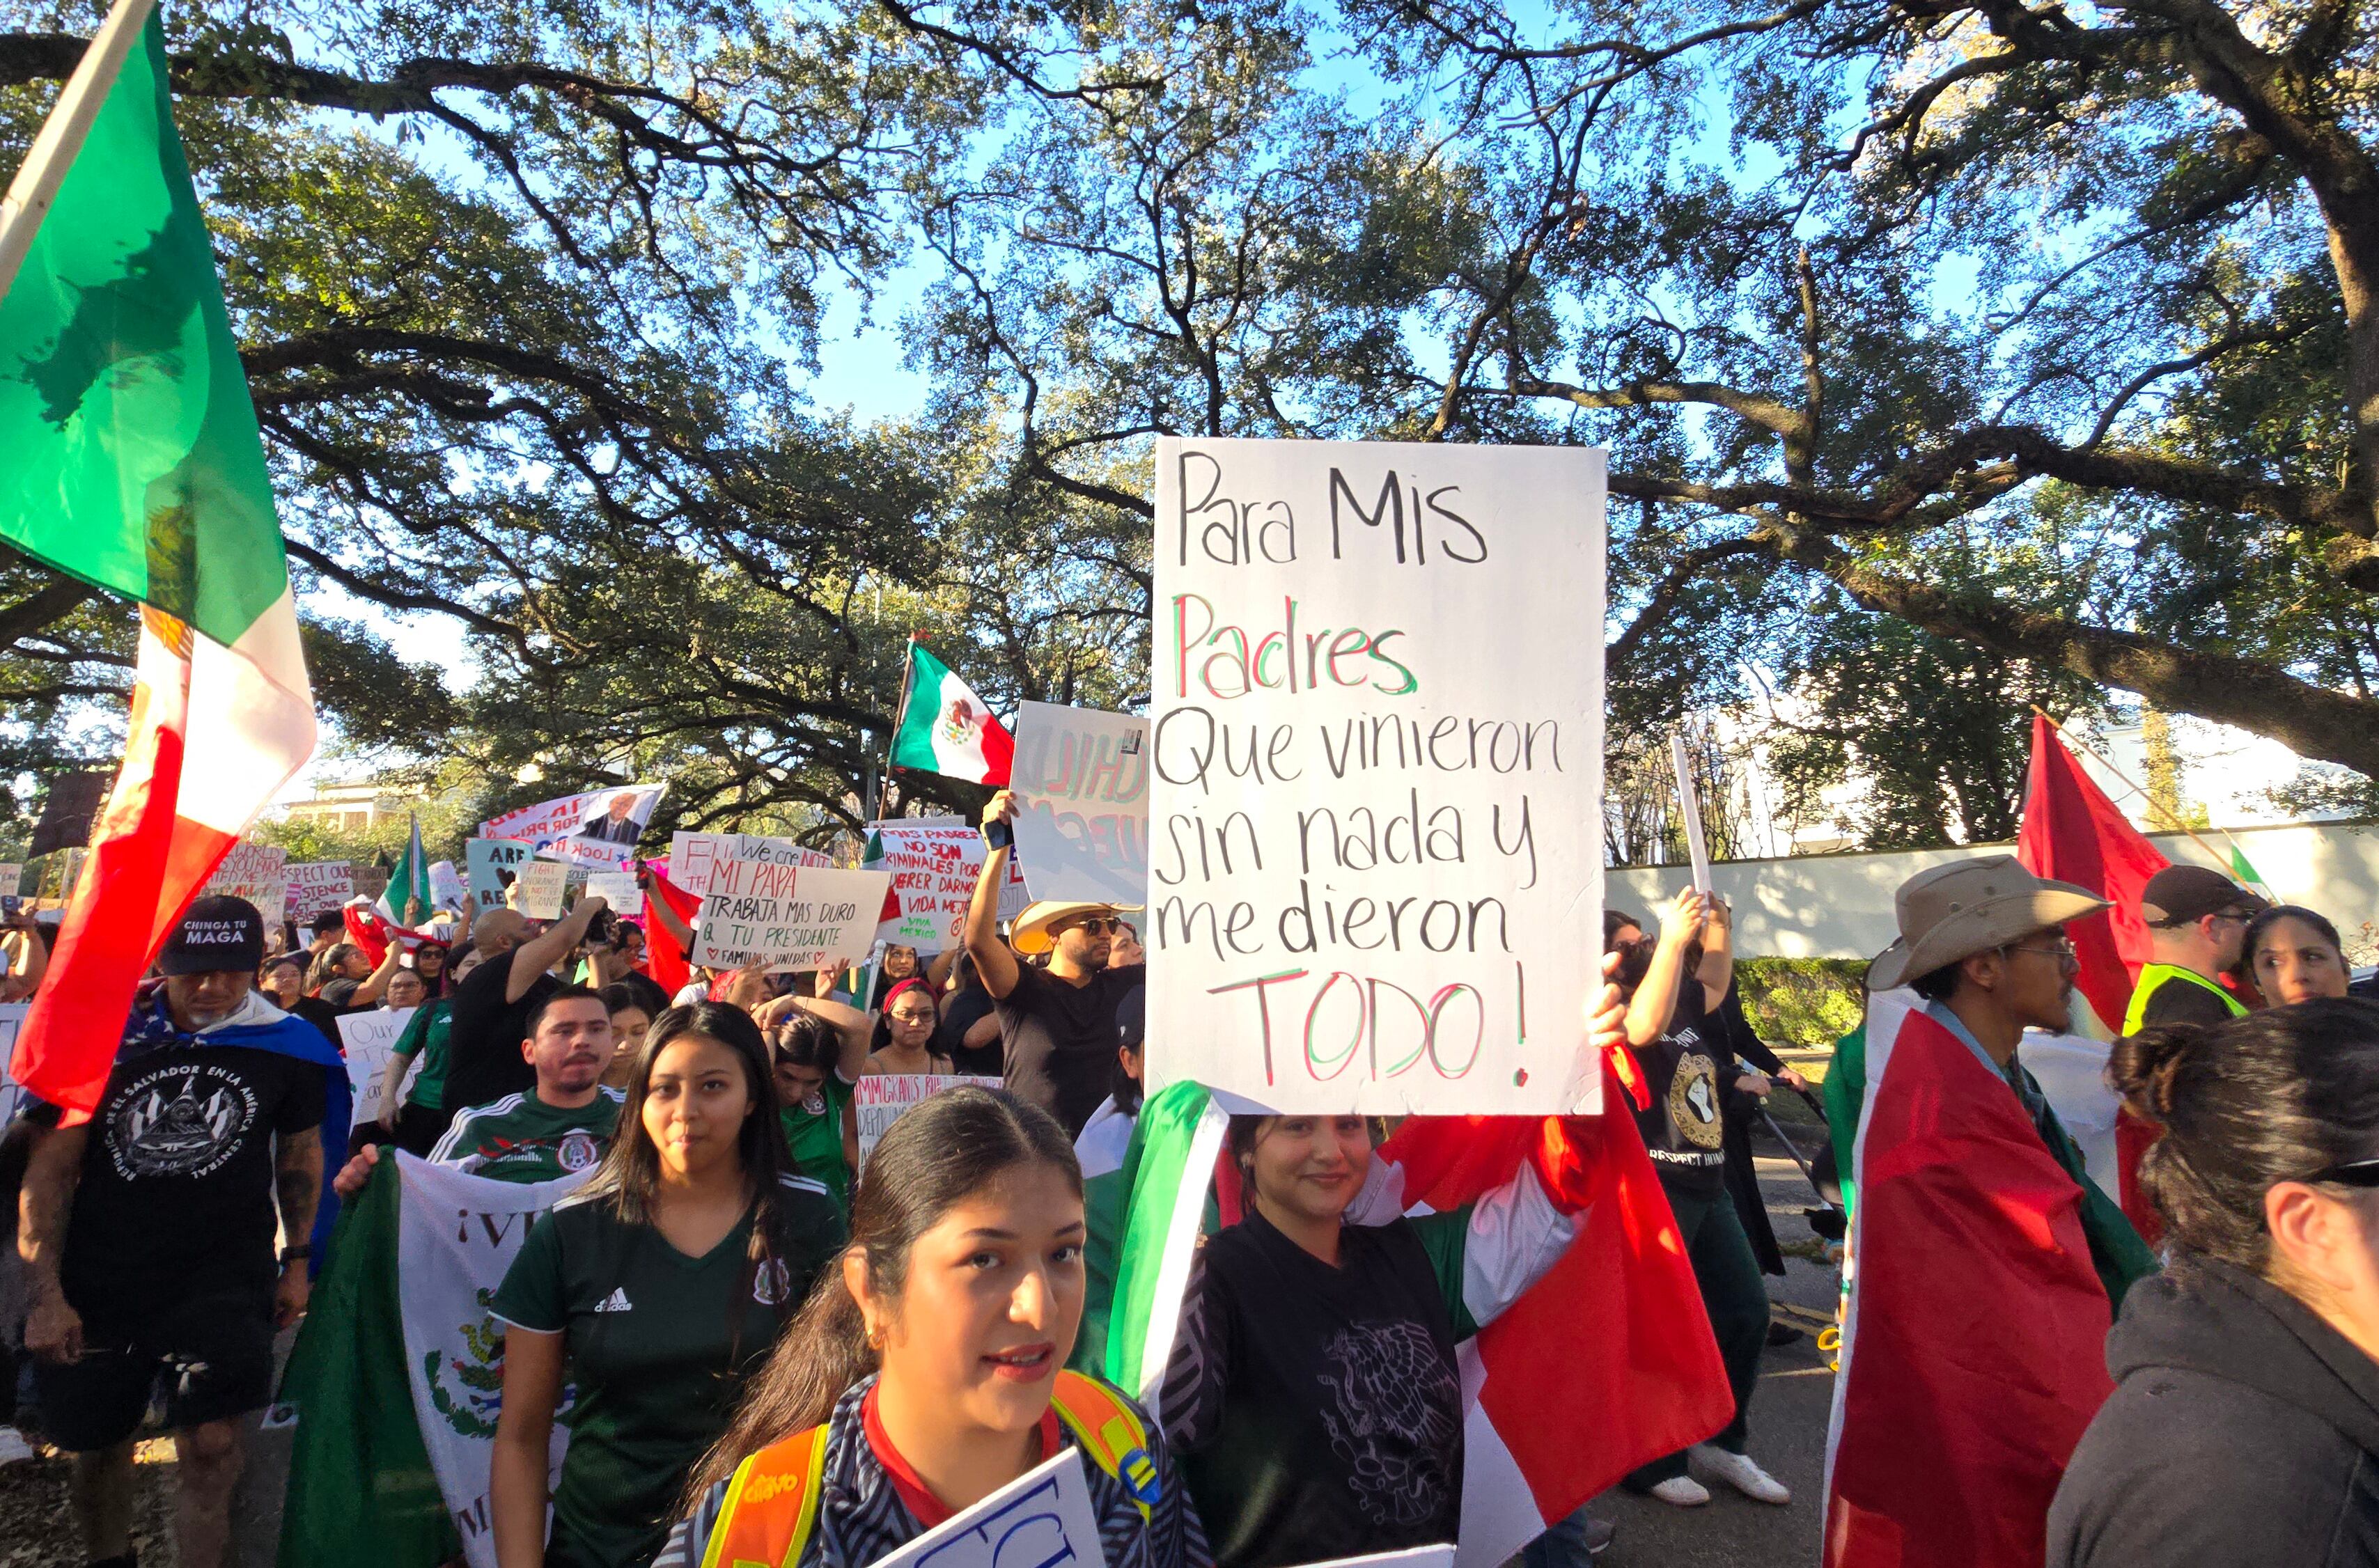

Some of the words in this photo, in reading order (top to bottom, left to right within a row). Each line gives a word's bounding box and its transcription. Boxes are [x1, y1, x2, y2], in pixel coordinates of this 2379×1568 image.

[1178, 452, 1296, 566] Para
[1173, 593, 1418, 698] Padres
[1153, 707, 1302, 795] Que
[1320, 706, 1563, 778] vinieron
[923, 830, 978, 840] PADRES
[1155, 806, 1263, 884] sin
[1298, 787, 1465, 874] nada
[1493, 794, 1537, 890] y
[742, 835, 772, 862] We
[800, 849, 831, 868] NOT
[903, 841, 926, 853] NO
[930, 842, 962, 860] SON
[280, 865, 325, 883] ESPECT
[330, 865, 351, 879] OUR
[527, 863, 558, 875] FIGHT
[885, 851, 954, 875] RIMINALES
[960, 862, 981, 878] POR
[708, 859, 744, 895] MI
[750, 862, 797, 900] PAPA
[481, 891, 508, 905] RE
[908, 895, 937, 914] VIDA
[706, 894, 778, 922] TRABAJA
[785, 902, 813, 924] MAS
[819, 903, 856, 923] DURO
[184, 920, 231, 930] CHINGA
[234, 920, 247, 930] TU
[907, 917, 931, 927] VIVA
[1157, 895, 1264, 962] me
[1279, 879, 1514, 953] dieron
[185, 930, 244, 944] MAGA
[703, 923, 715, 943] Q
[731, 925, 755, 946] TU
[763, 927, 842, 948] PRESIDENTE
[899, 926, 937, 939] MEXICO
[774, 951, 813, 966] UNIDAS
[350, 1019, 394, 1044] Our
[124, 1065, 200, 1096] SALVADOR
[207, 1066, 227, 1079] EN
[226, 1073, 242, 1086] LA
[855, 1076, 919, 1106] IMMIGRANTS
[111, 1097, 127, 1111] EL
[106, 1109, 116, 1124] DE
[191, 1138, 242, 1179] CENTRAL
[1649, 1149, 1701, 1166] RESPECT
